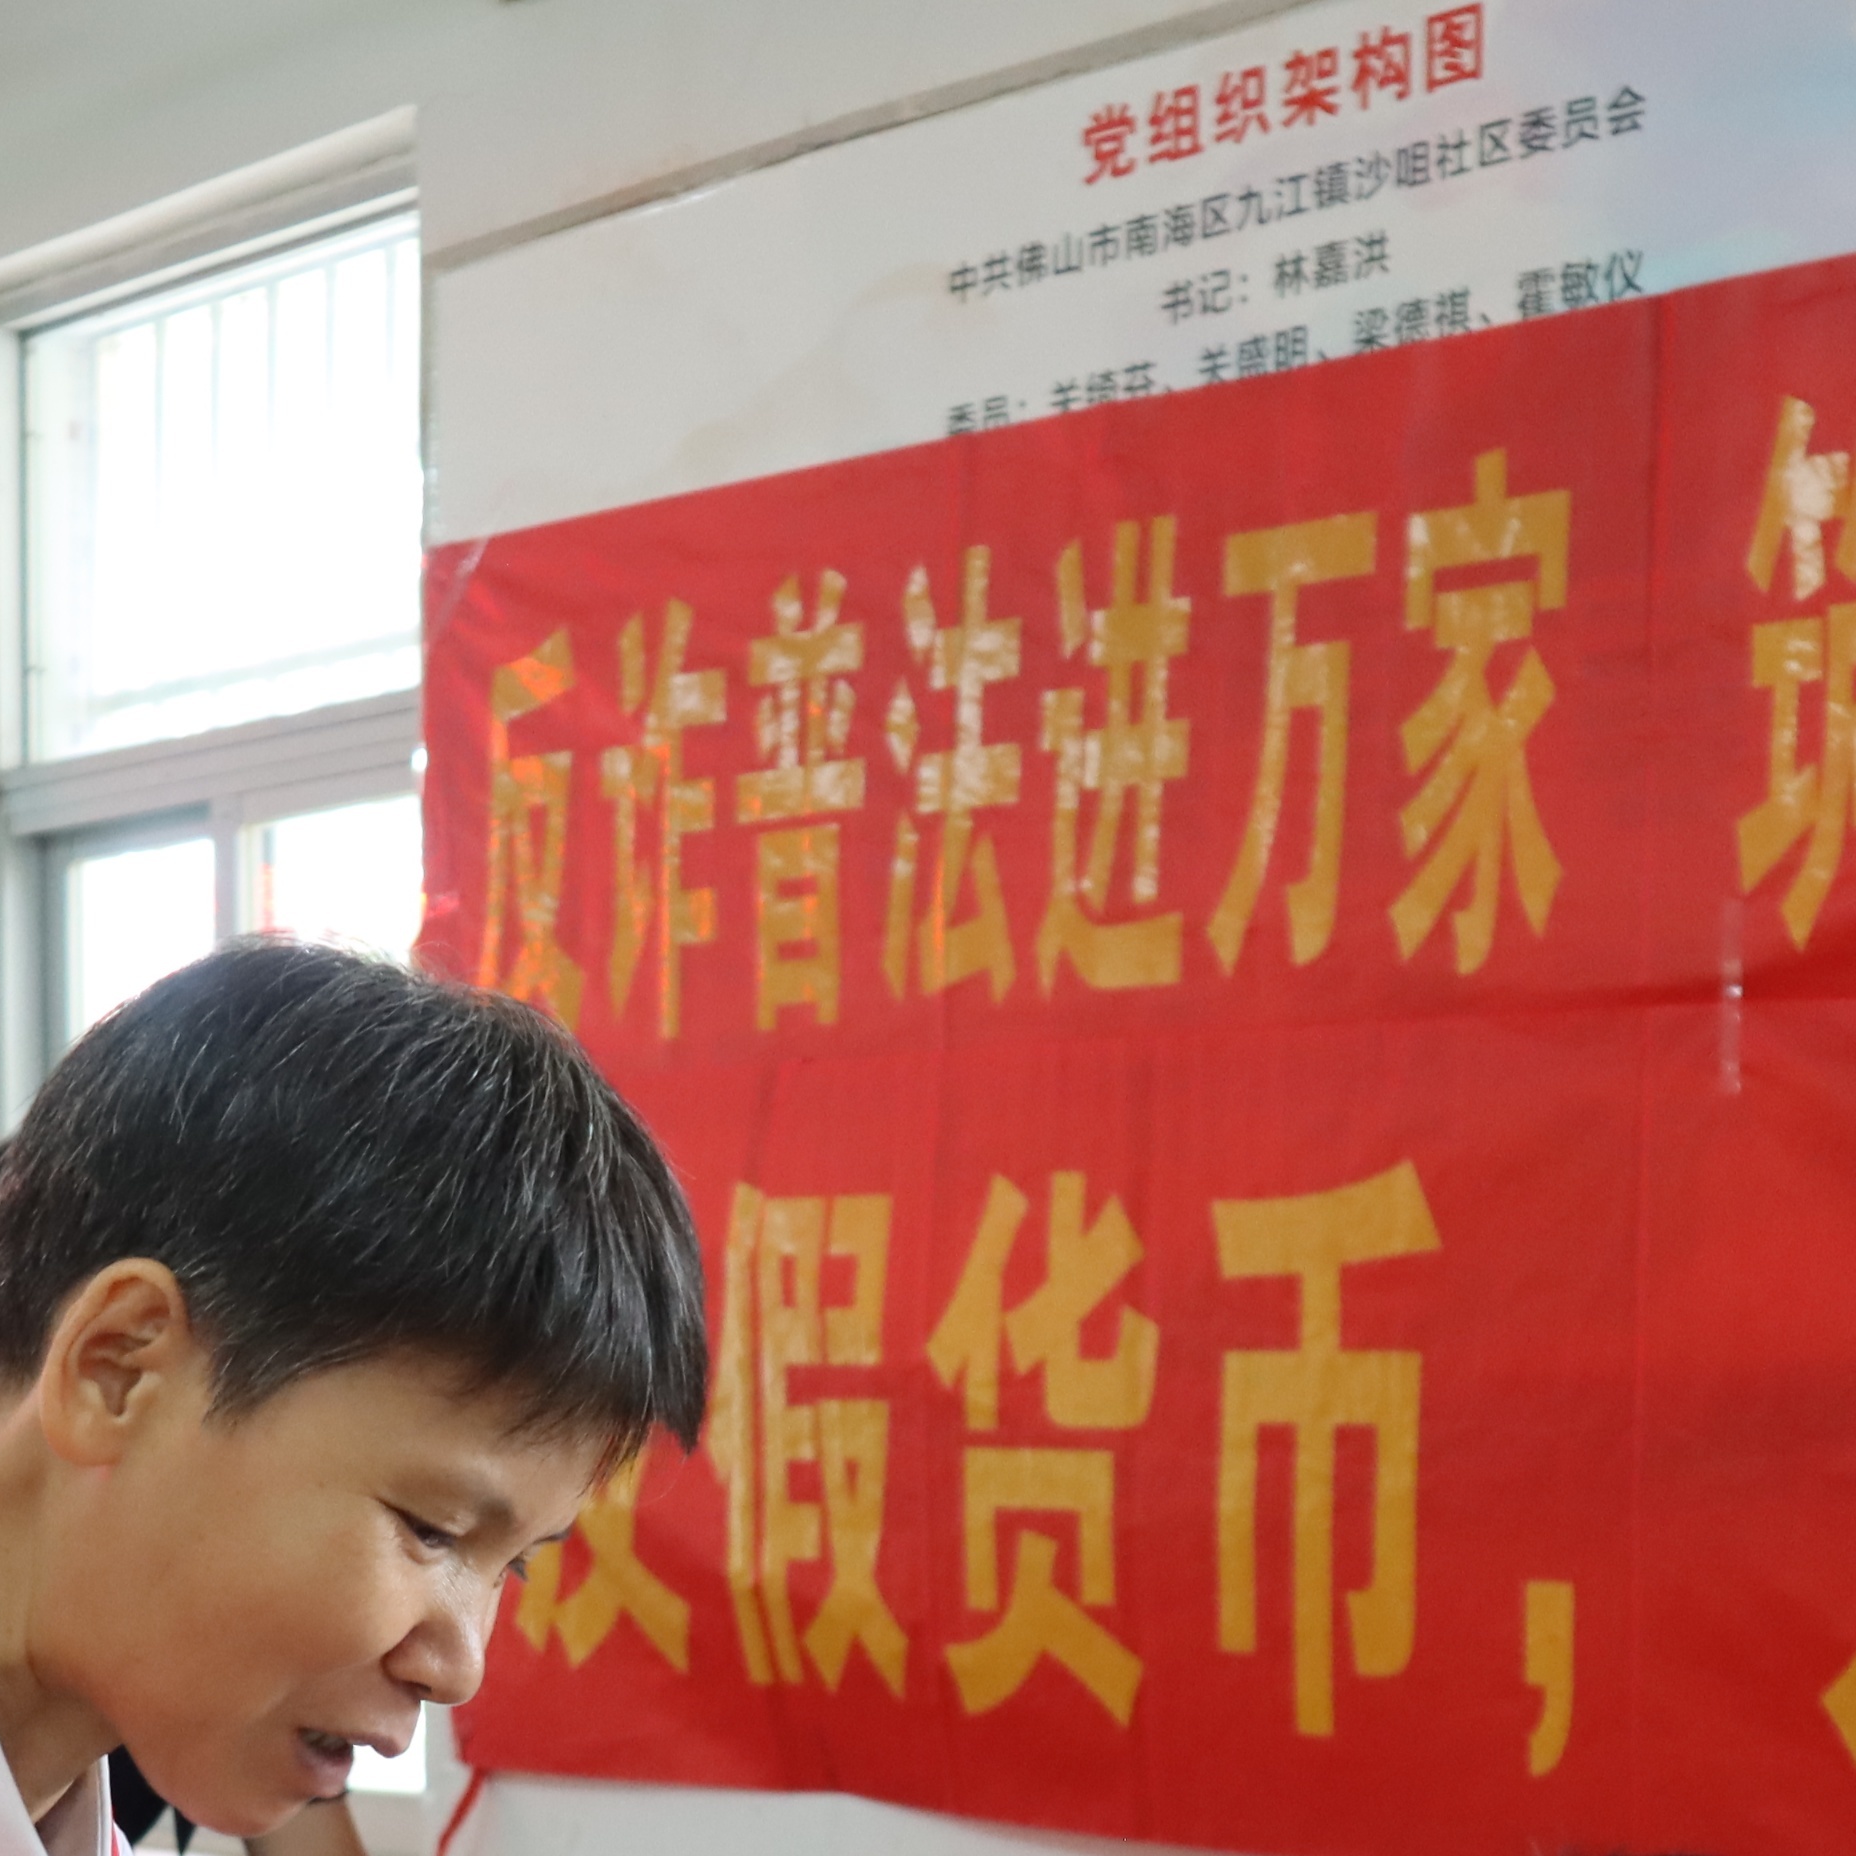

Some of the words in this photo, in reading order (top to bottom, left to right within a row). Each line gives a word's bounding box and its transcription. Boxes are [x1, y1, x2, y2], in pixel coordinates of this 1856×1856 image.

[1081, 3, 1485, 186] 党组织架构图
[476, 446, 1572, 1040] 反诈普法进万家
